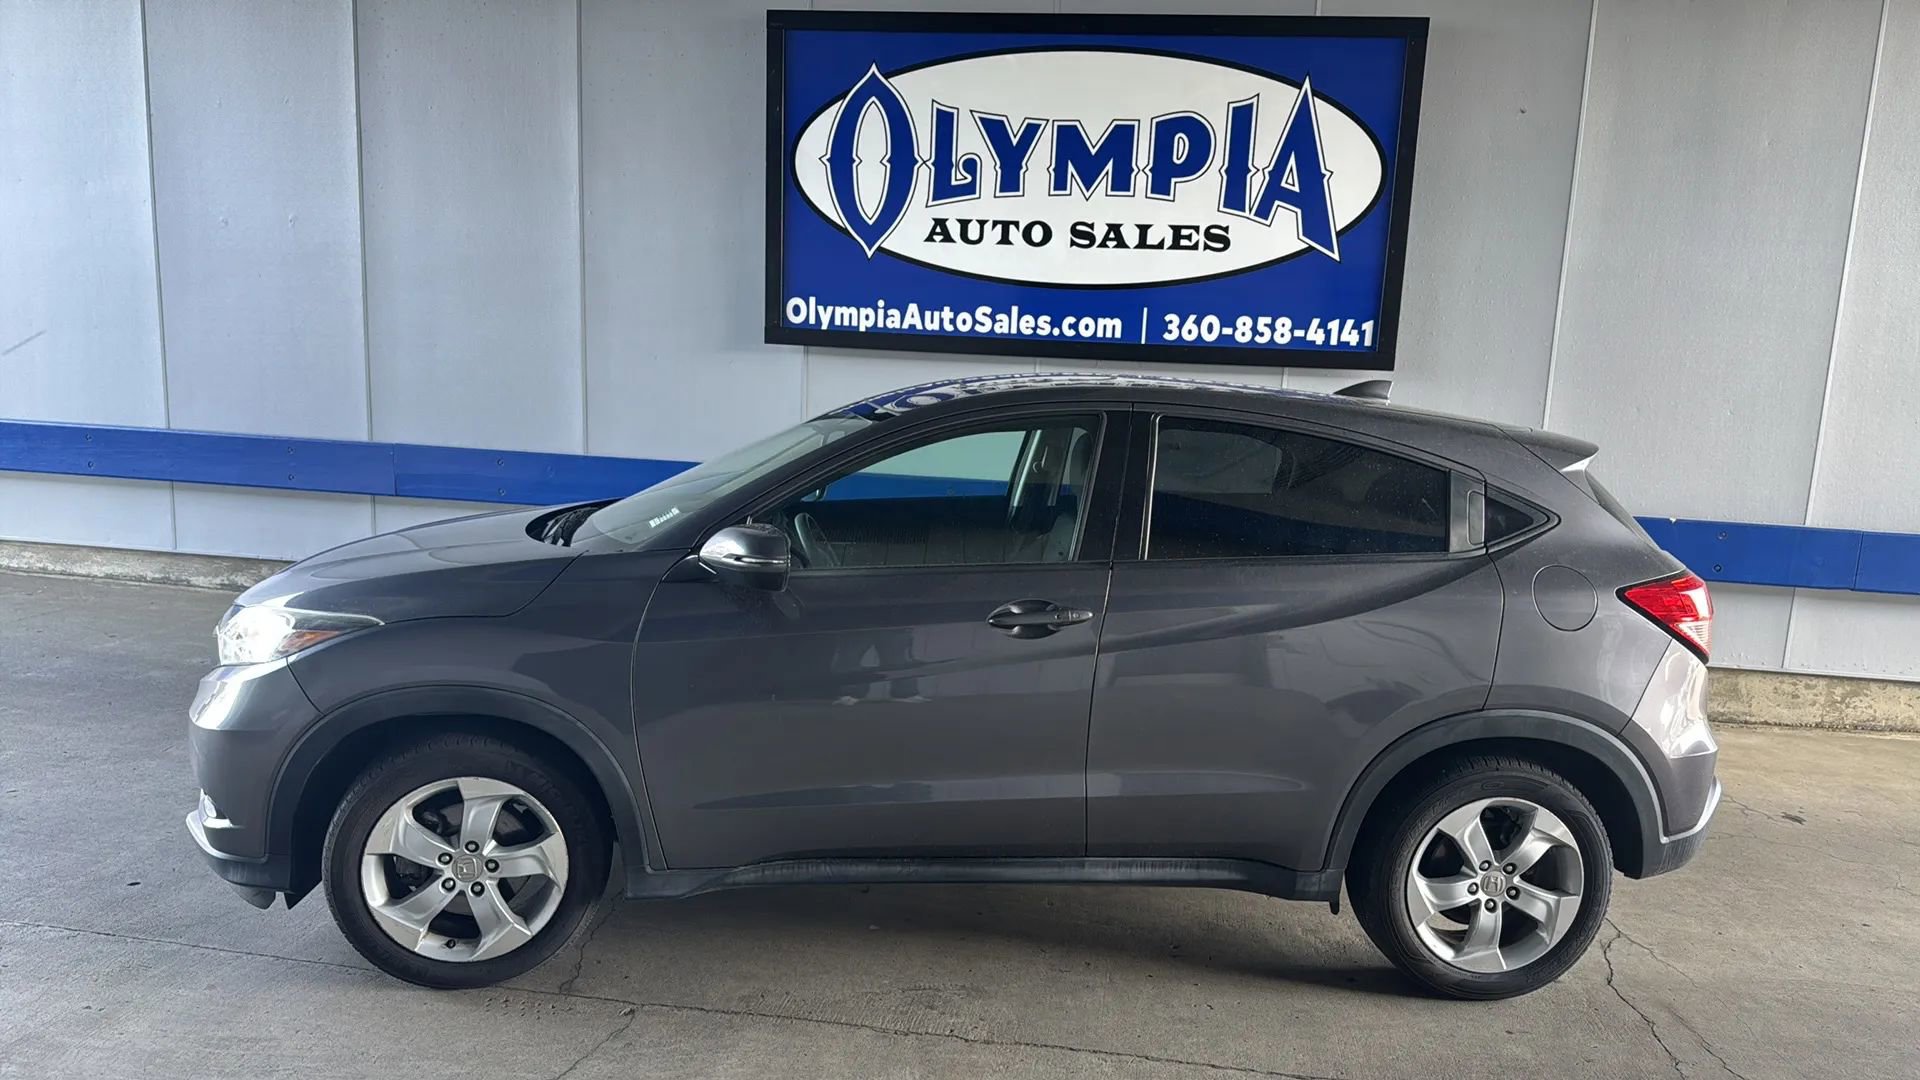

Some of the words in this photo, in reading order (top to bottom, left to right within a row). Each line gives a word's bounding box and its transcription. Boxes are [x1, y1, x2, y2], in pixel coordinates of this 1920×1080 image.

[818, 61, 1341, 263] OLYMPIA
[923, 217, 1053, 247] AUTO
[1069, 221, 1231, 253] SALES
[785, 296, 1123, 338] OlympiaAutoSales.com
[1162, 313, 1375, 347] 360-858-4141
